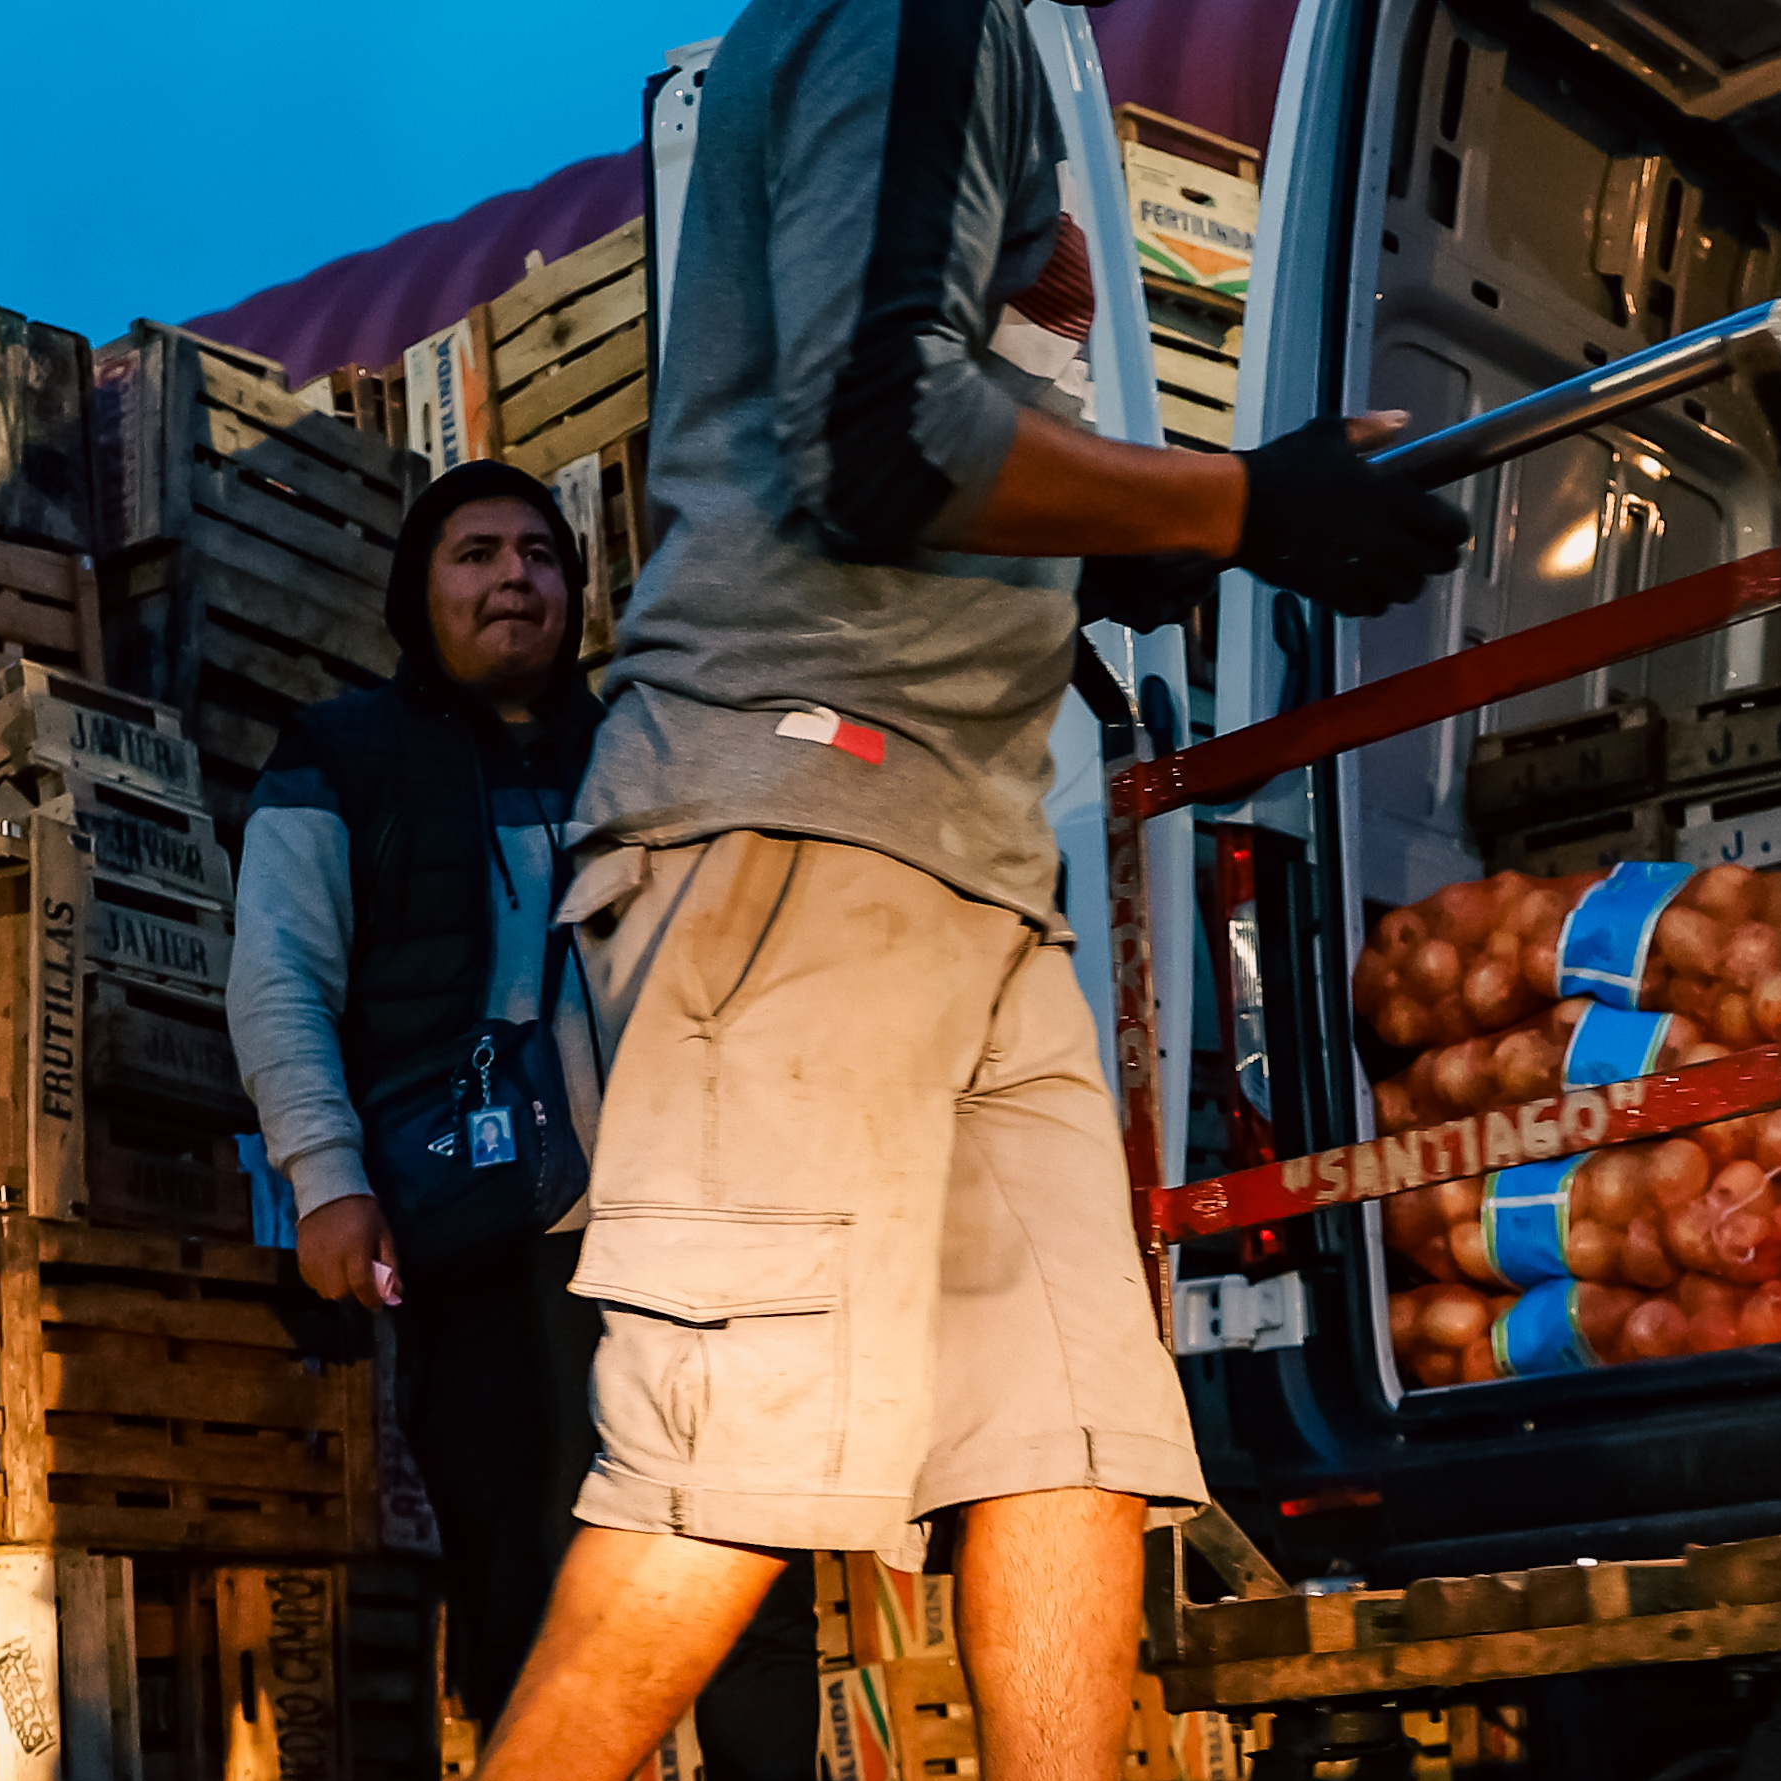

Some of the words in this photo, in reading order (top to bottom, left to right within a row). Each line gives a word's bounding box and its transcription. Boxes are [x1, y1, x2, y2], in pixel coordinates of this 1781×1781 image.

[103, 908, 208, 977] JAVIER
[42, 896, 76, 1122] FRUTILLAS
[265, 1576, 325, 1685] CAMPO
